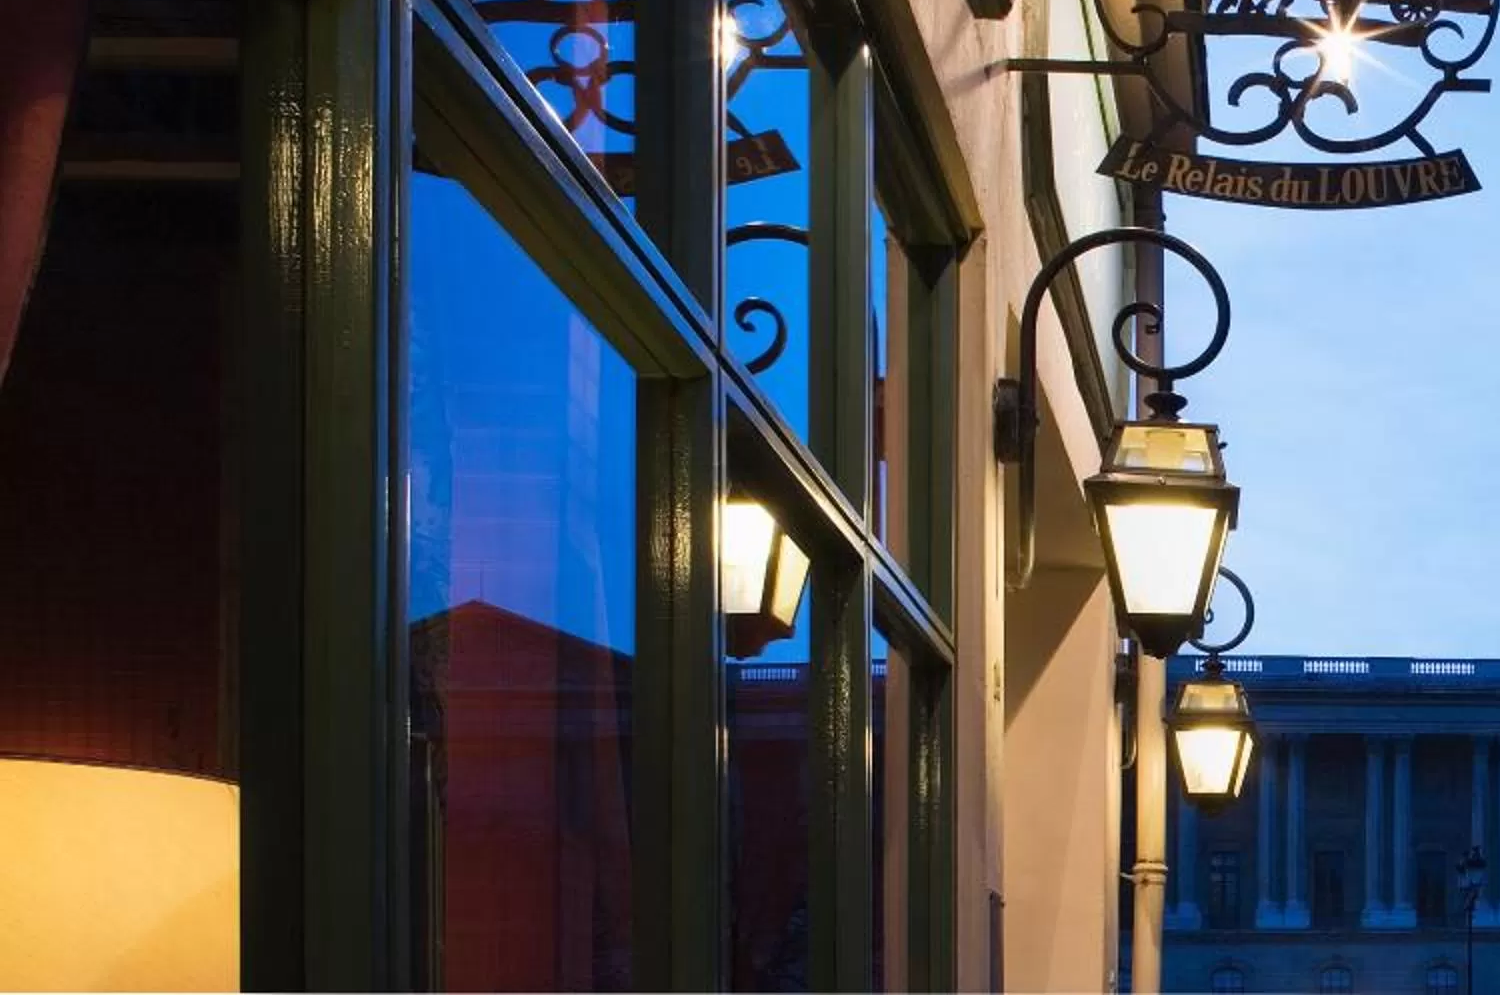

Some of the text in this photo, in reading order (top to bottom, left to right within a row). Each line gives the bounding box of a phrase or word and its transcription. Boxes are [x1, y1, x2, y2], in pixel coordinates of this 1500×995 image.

[1119, 142, 1465, 205] Le Relais du LOUVRE
